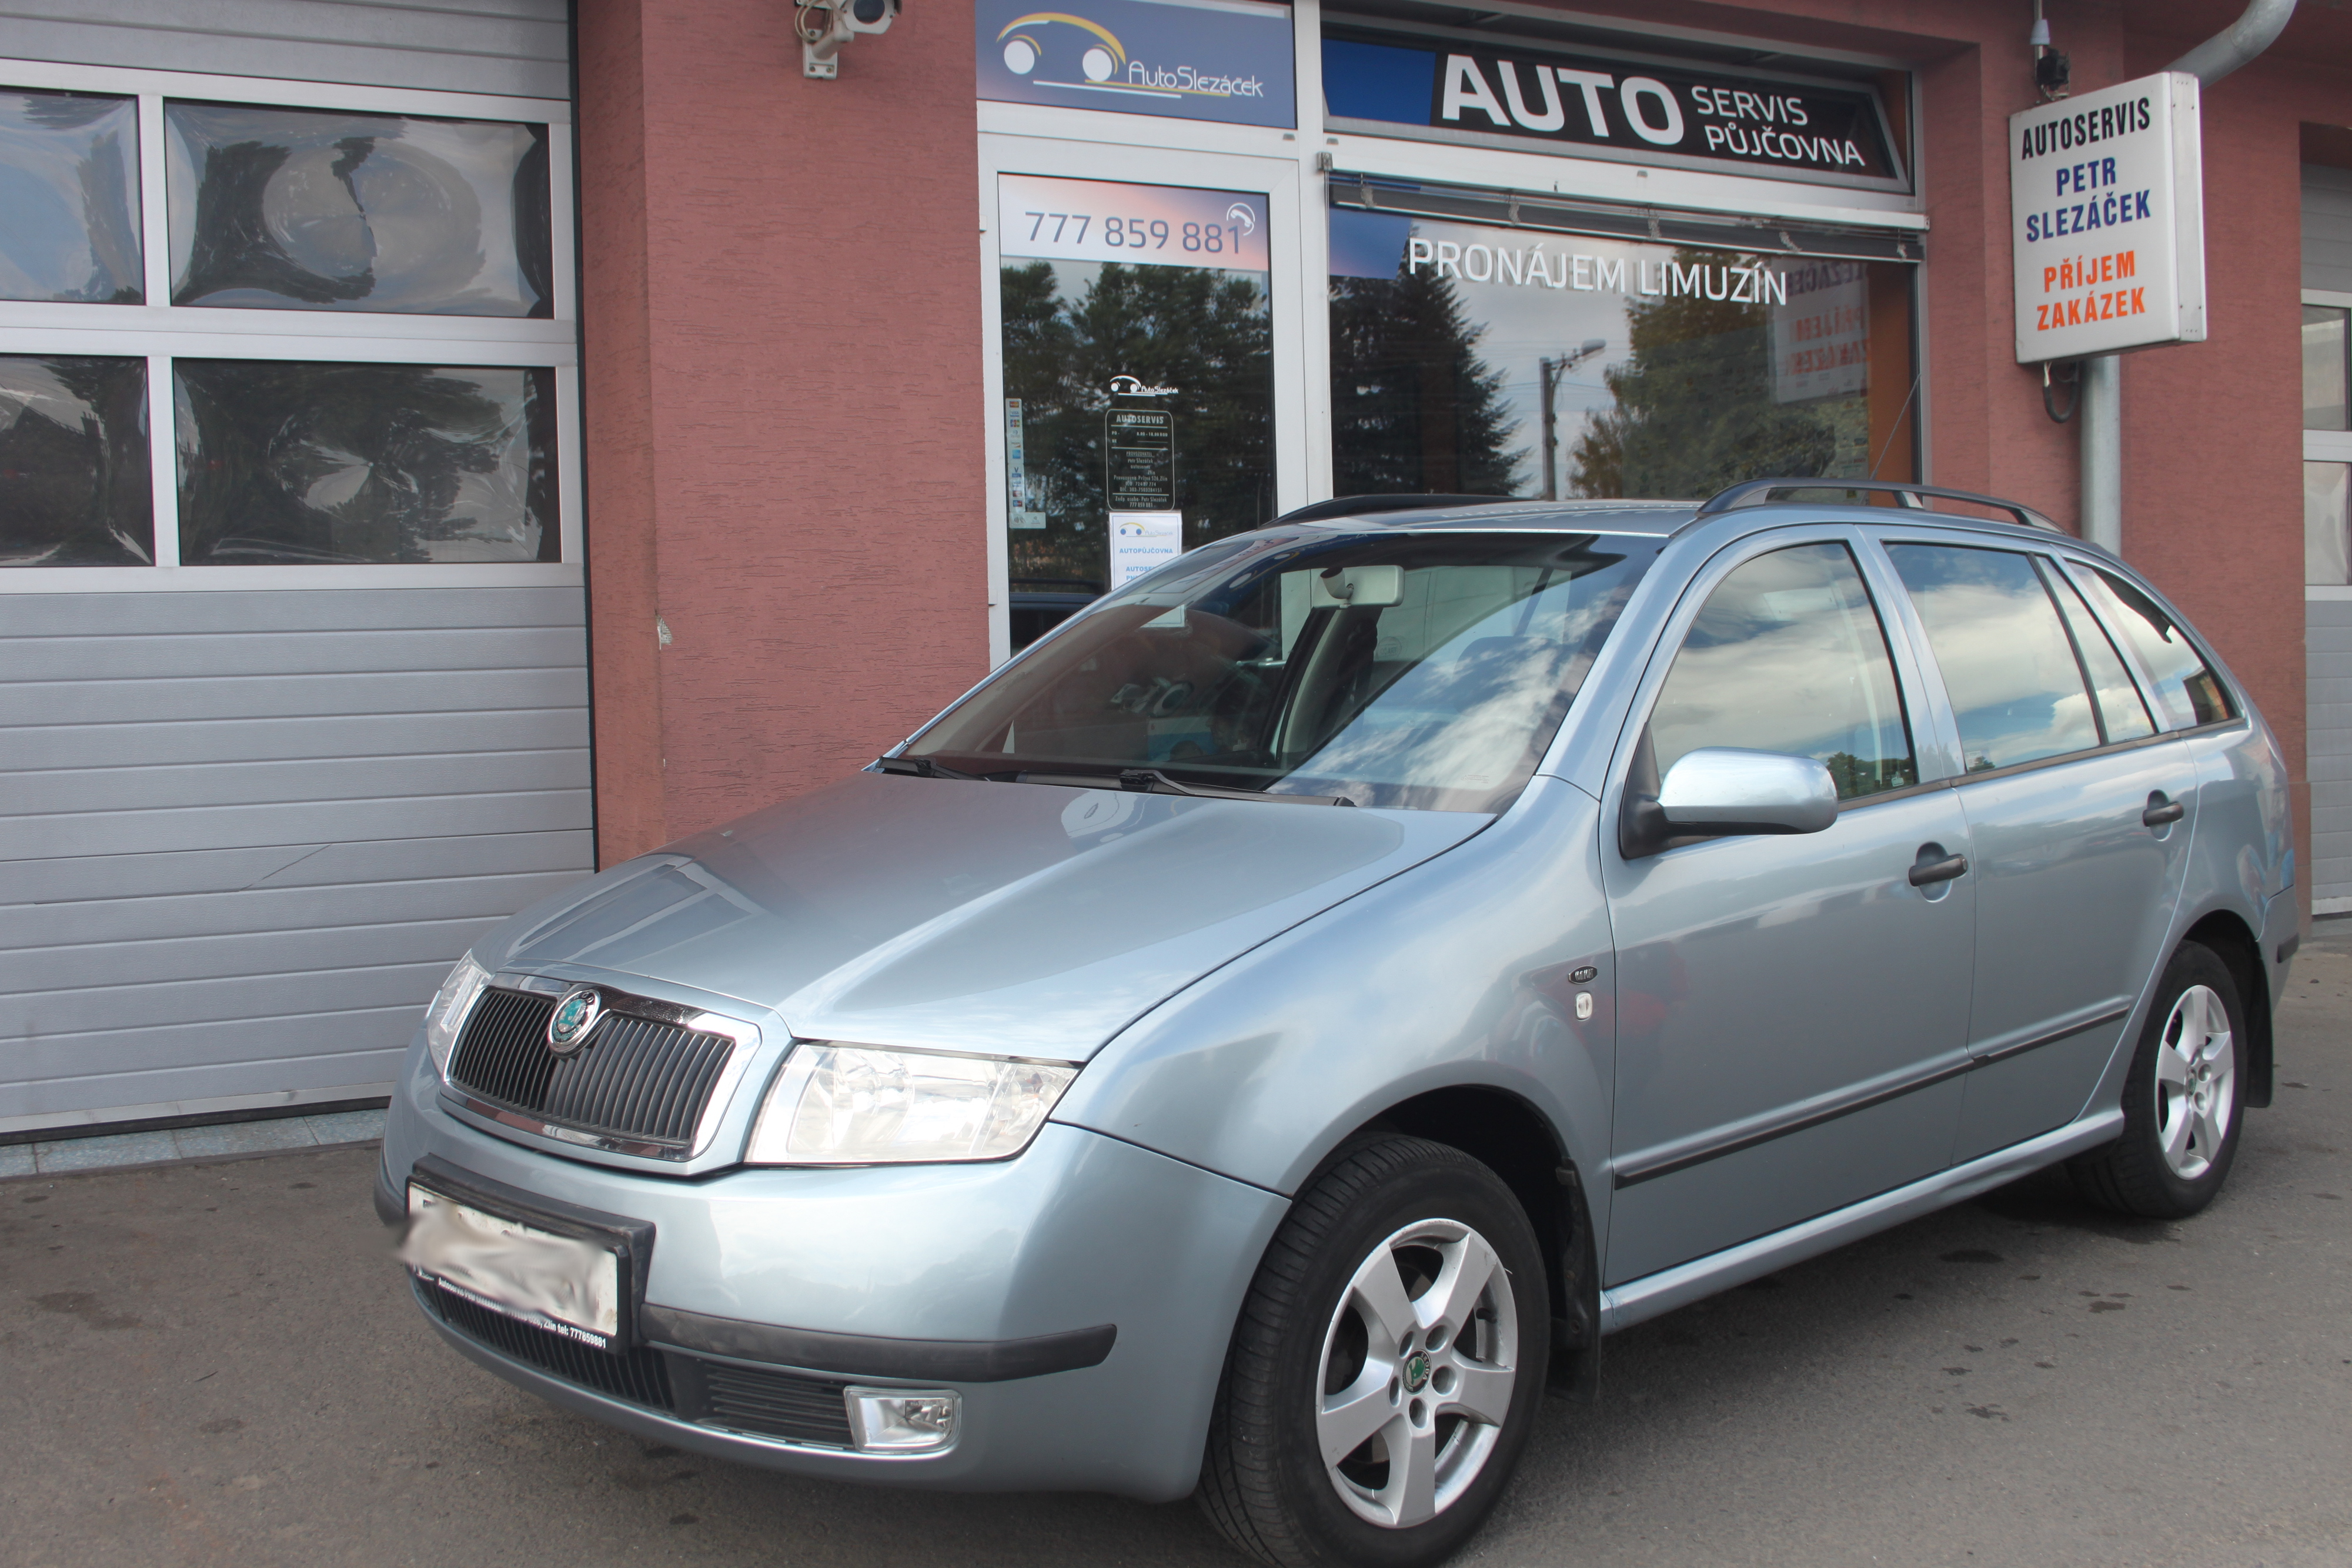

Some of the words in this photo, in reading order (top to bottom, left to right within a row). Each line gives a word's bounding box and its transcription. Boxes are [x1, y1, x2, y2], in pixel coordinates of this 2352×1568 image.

[1128, 61, 1264, 98] AutoSlezáček
[1442, 54, 1684, 145] AUTO
[1690, 85, 1808, 126] SERVIS
[2021, 96, 2150, 160] AUTOSERVIS
[1703, 121, 1866, 167] PŮJČOVNA
[2056, 156, 2117, 197] PETR
[1025, 210, 1092, 245] 777
[1104, 216, 1170, 249] 859
[1181, 221, 1240, 255] 881
[2026, 189, 2151, 243] SLEZÁČEK
[1408, 237, 1626, 293] PRONÁJEM
[1641, 259, 1786, 306] LIMUZÍN
[2043, 249, 2135, 293] PŘÍJEM
[2036, 286, 2146, 331] ZAKÁZEK
[1116, 414, 1164, 424] AUTOSERVIS
[558, 1323, 569, 1336] tel:
[570, 1326, 606, 1349] 777859881
